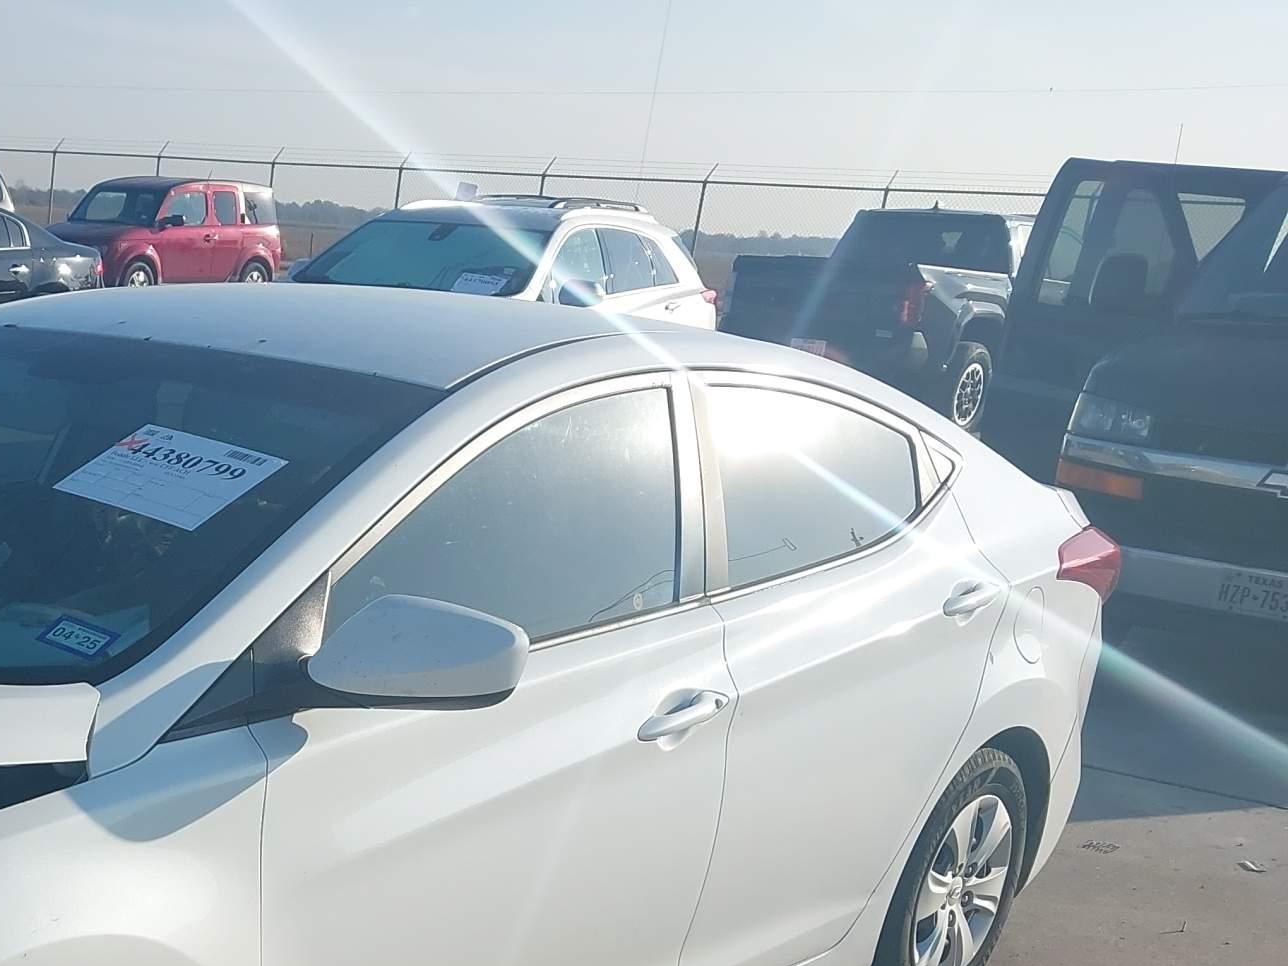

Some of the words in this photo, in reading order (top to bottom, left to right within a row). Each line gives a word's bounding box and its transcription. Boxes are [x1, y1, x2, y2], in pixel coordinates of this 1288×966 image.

[129, 441, 247, 481] 44380799
[1247, 575, 1283, 588] TEXAS
[52, 626, 73, 641] 04
[77, 635, 100, 650] 25
